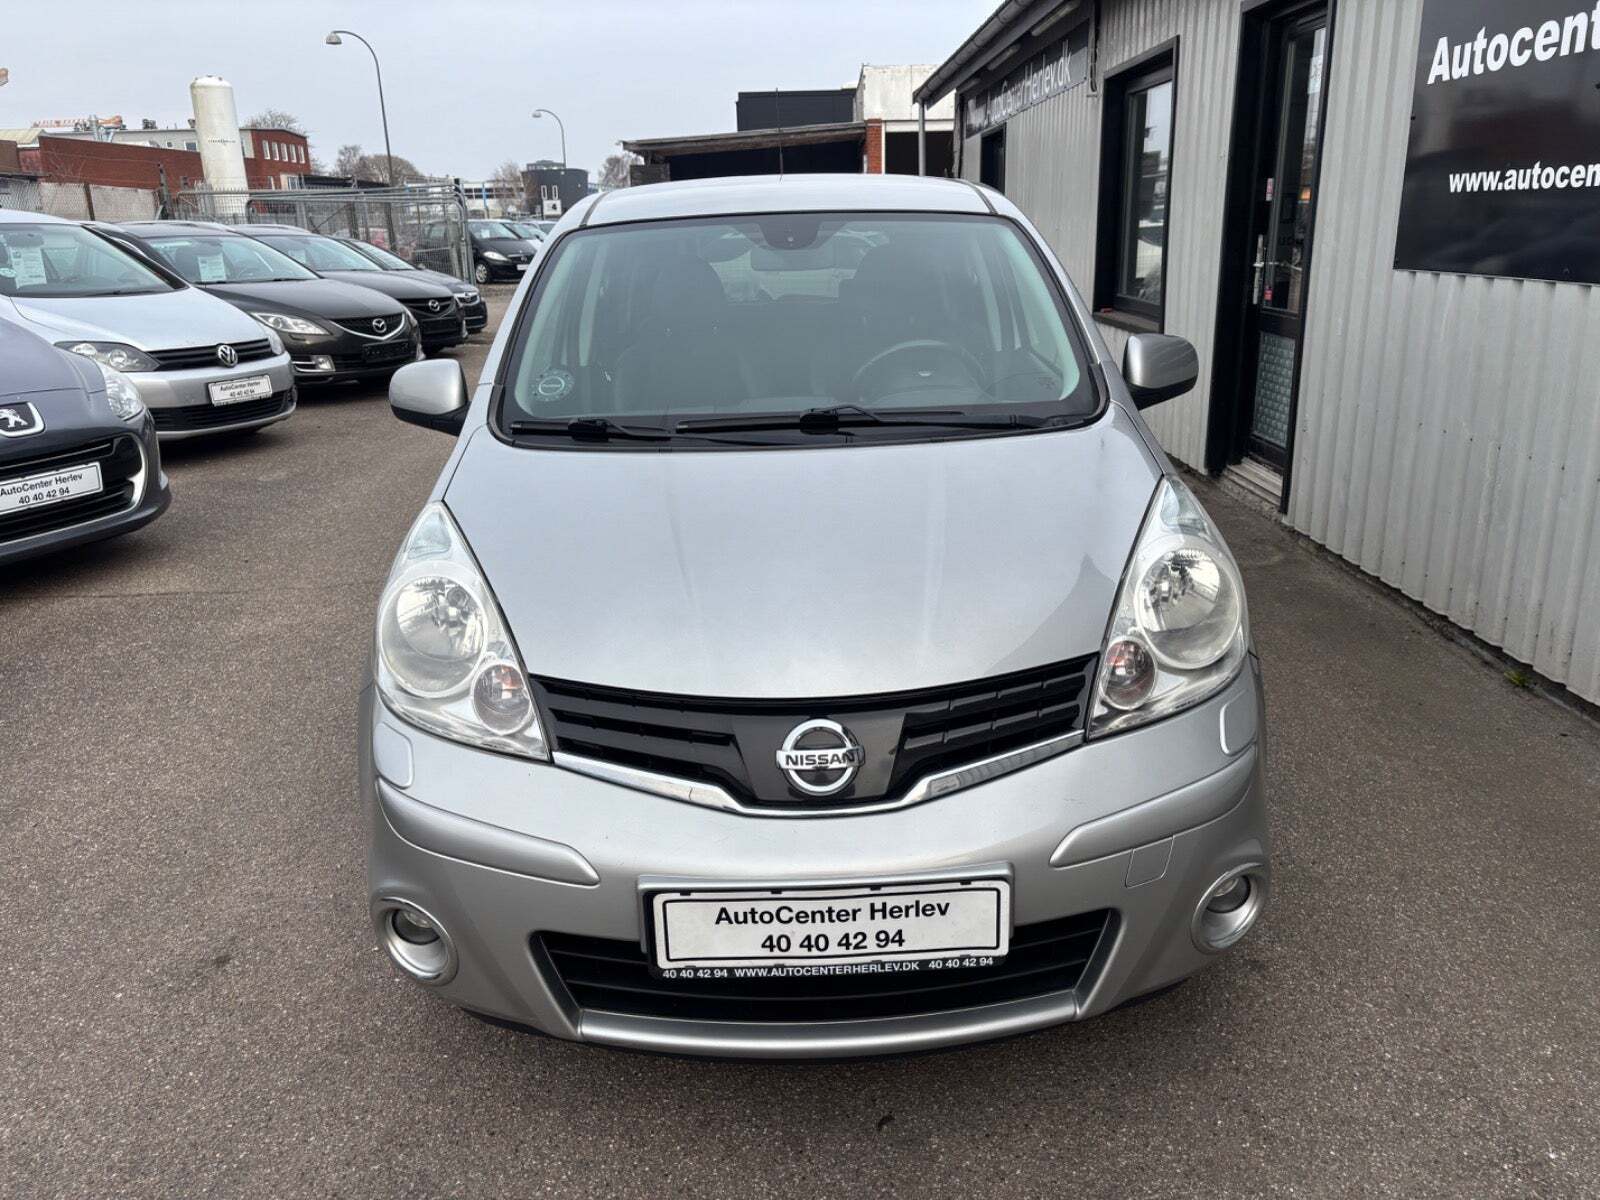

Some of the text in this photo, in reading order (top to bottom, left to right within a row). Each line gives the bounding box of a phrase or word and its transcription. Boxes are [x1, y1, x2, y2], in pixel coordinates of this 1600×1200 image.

[0, 473, 83, 496] AutoCenter Herlev
[19, 486, 70, 505] 40 40 42 94
[785, 752, 855, 766] NISSAN
[715, 900, 950, 925] AutoCenter Herlev
[761, 929, 905, 952] 40 40 42 94
[663, 957, 994, 978] 40 40 42 94 WWW.AUTOCENTERHERLEV.DK 40 40 42 94
